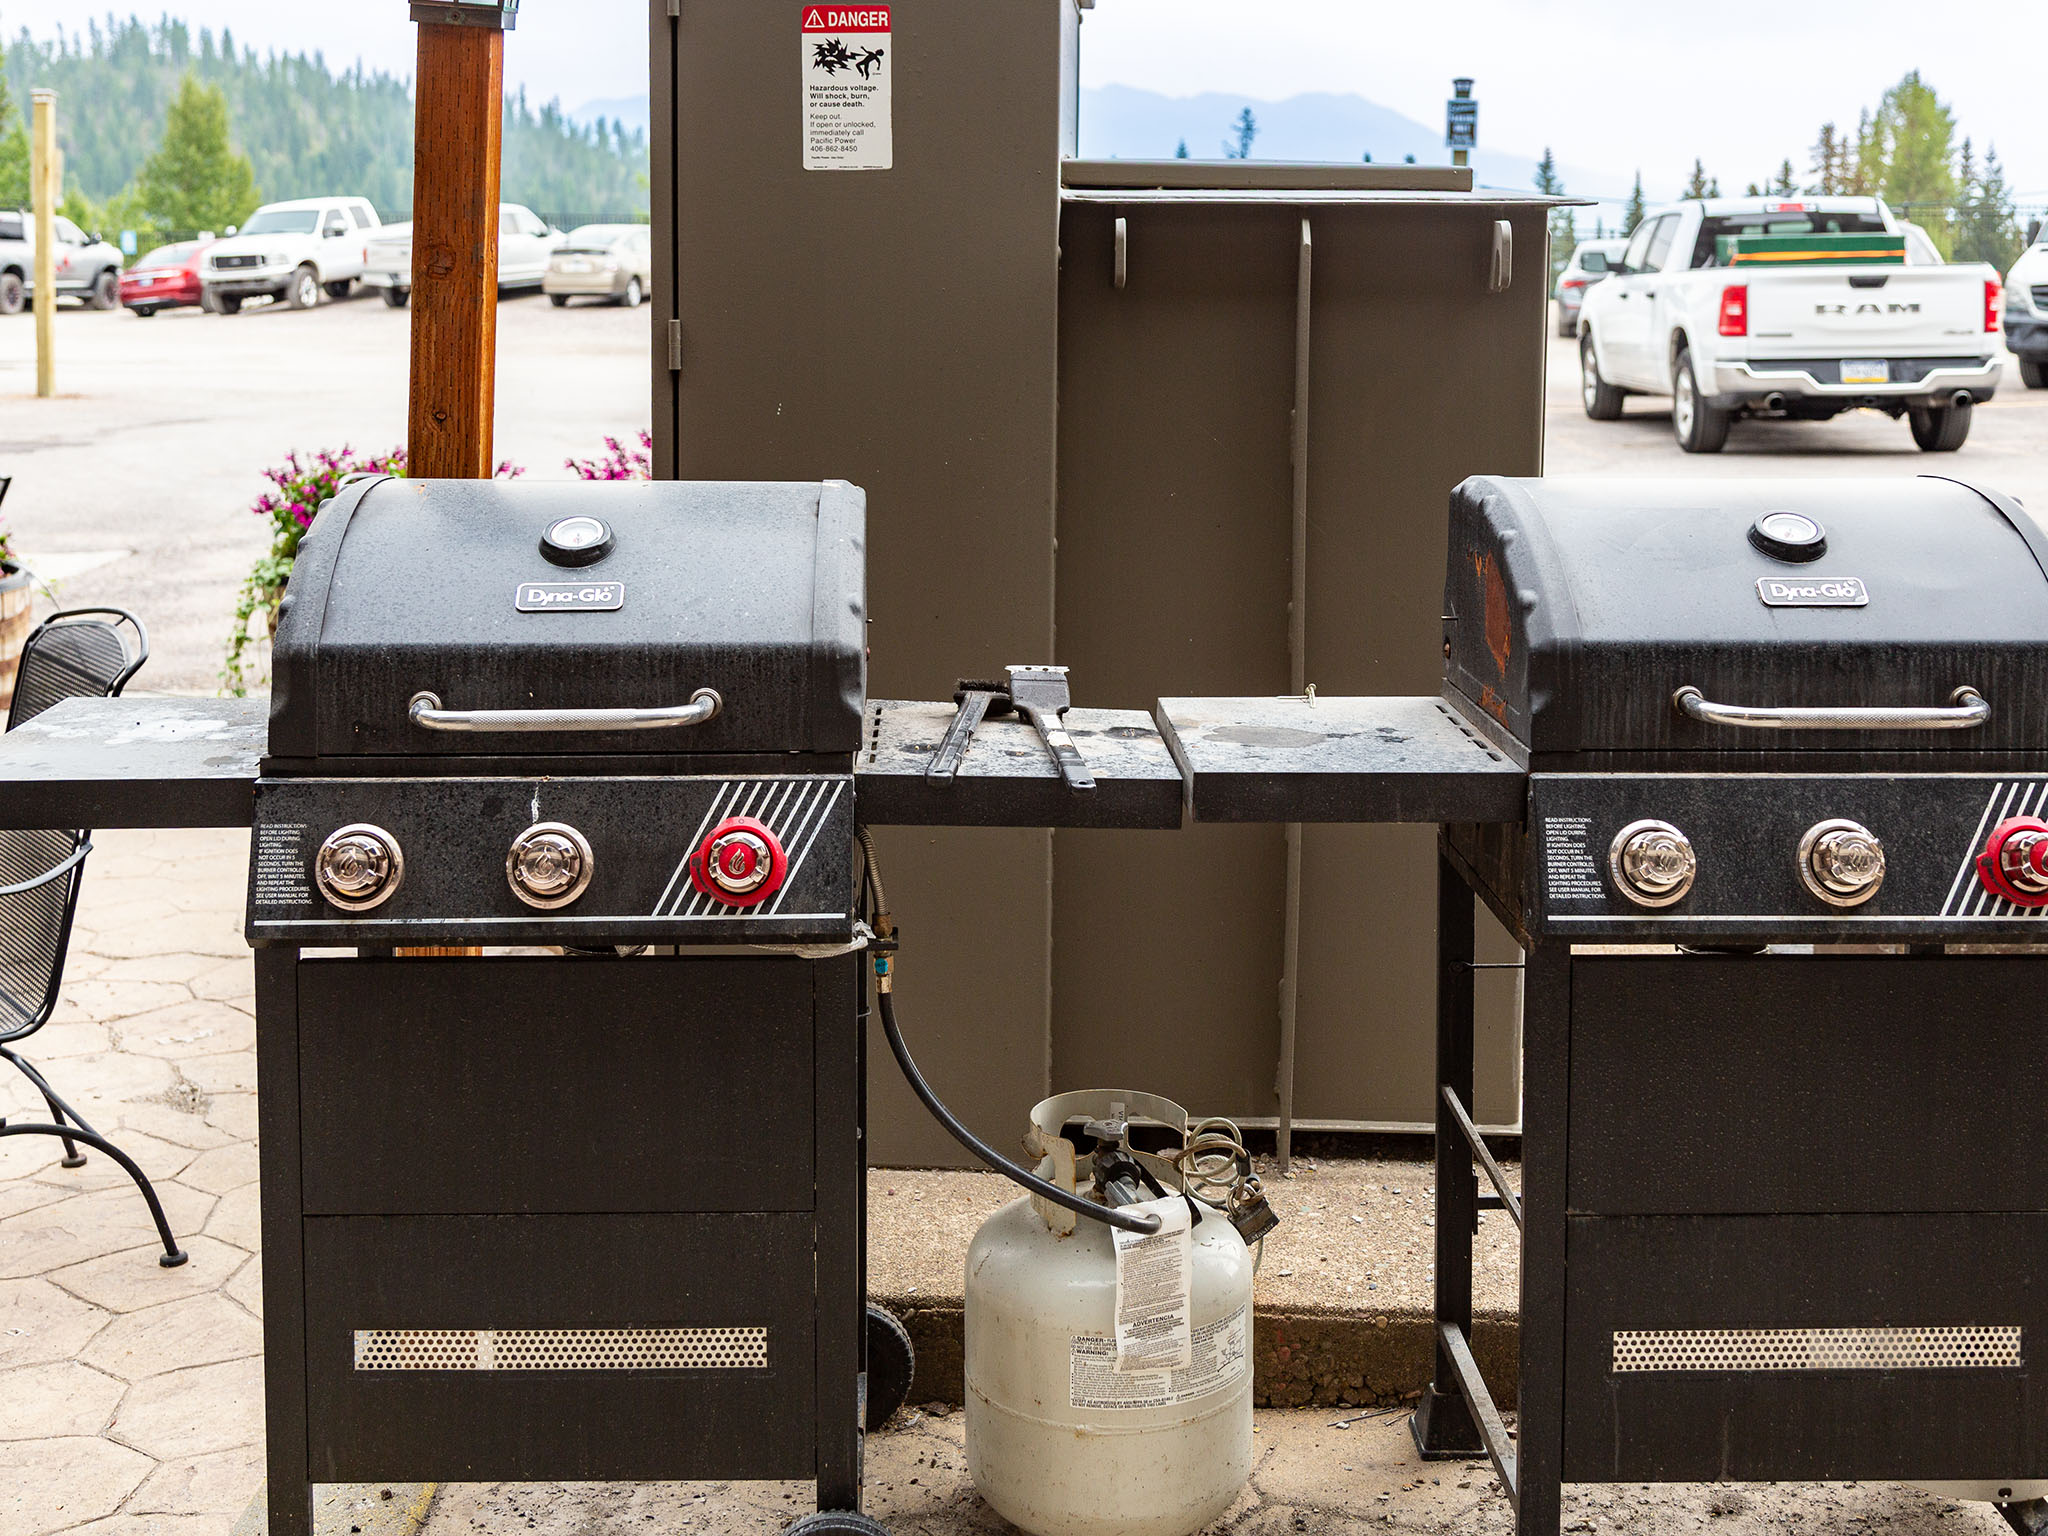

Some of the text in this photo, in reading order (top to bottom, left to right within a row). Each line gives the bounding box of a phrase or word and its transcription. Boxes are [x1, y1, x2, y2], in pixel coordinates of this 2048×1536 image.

[828, 11, 888, 27] DANGER
[1816, 304, 1921, 314] RAM
[1132, 1314, 1174, 1327] ADVERTENCIA
